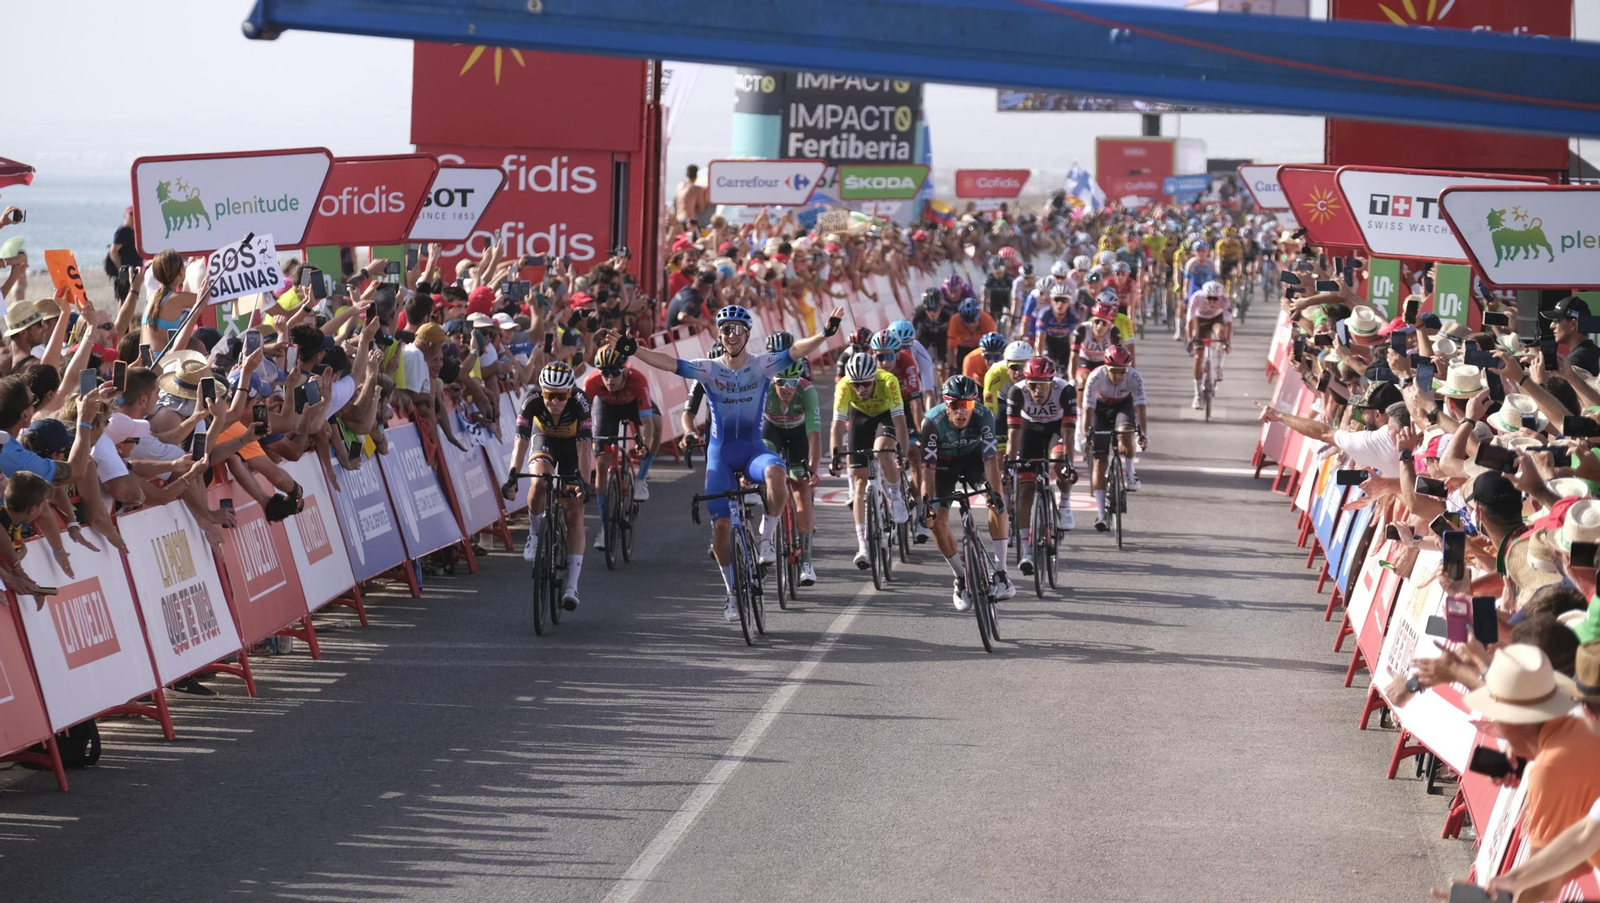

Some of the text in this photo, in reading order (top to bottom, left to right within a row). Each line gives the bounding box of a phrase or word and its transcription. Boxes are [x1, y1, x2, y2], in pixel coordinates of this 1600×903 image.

[788, 132, 910, 160] Fertiberia
[716, 175, 780, 188] Carrefour
[844, 175, 916, 190] ŠKODA
[976, 176, 1020, 189] Cofidis
[1255, 180, 1282, 192] Car
[215, 194, 300, 221] plenitude
[417, 211, 475, 220] INCE 1853
[1367, 219, 1404, 231] SWISS
[208, 242, 257, 277] SOS
[208, 266, 279, 298] SALINAS
[722, 396, 753, 404] Jayco
[1026, 403, 1058, 416] UAE
[68, 590, 114, 649] VUELTA
